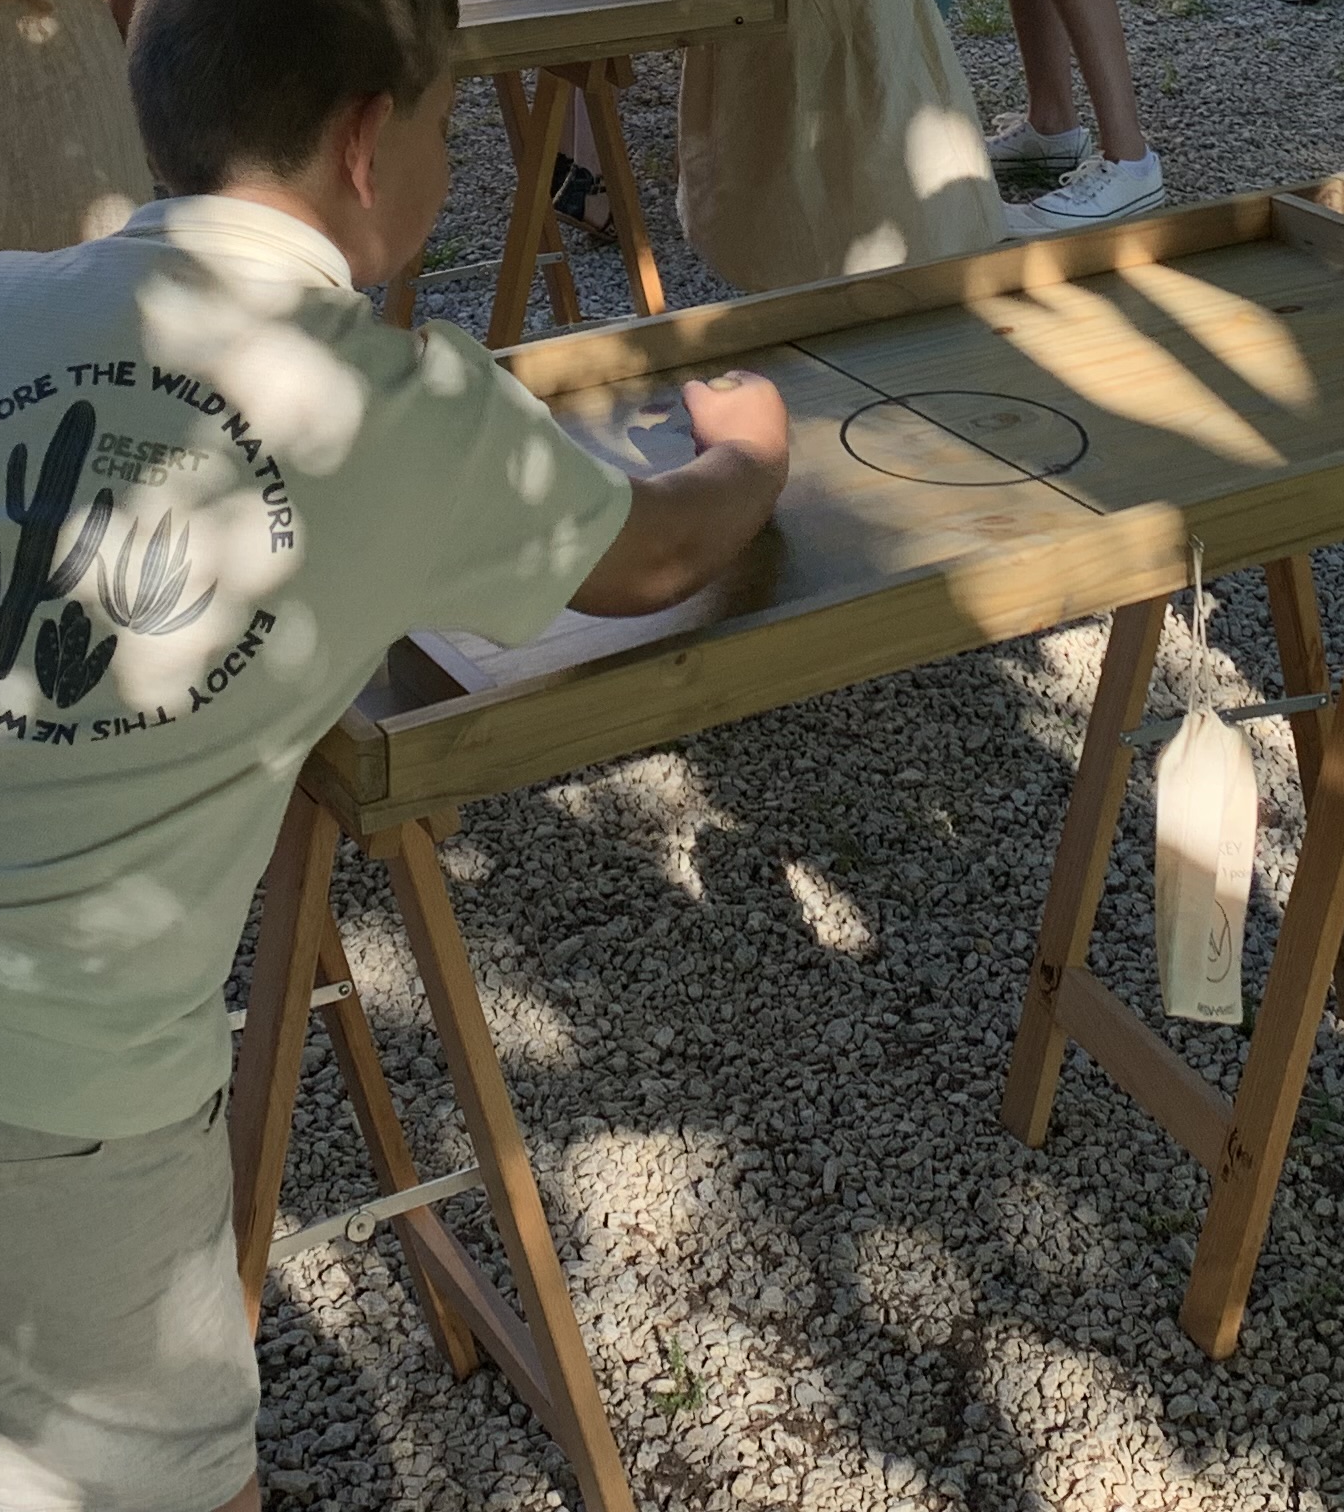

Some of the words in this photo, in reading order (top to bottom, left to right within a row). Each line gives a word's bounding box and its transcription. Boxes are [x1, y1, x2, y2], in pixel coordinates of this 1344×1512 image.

[67, 360, 137, 388] THE
[151, 366, 226, 416] WILD
[220, 411, 295, 554] NATURE
[92, 455, 167, 487] CHILD
[97, 432, 209, 471] DESERT
[187, 608, 277, 713] ENJOY
[90, 706, 177, 742] THIS
